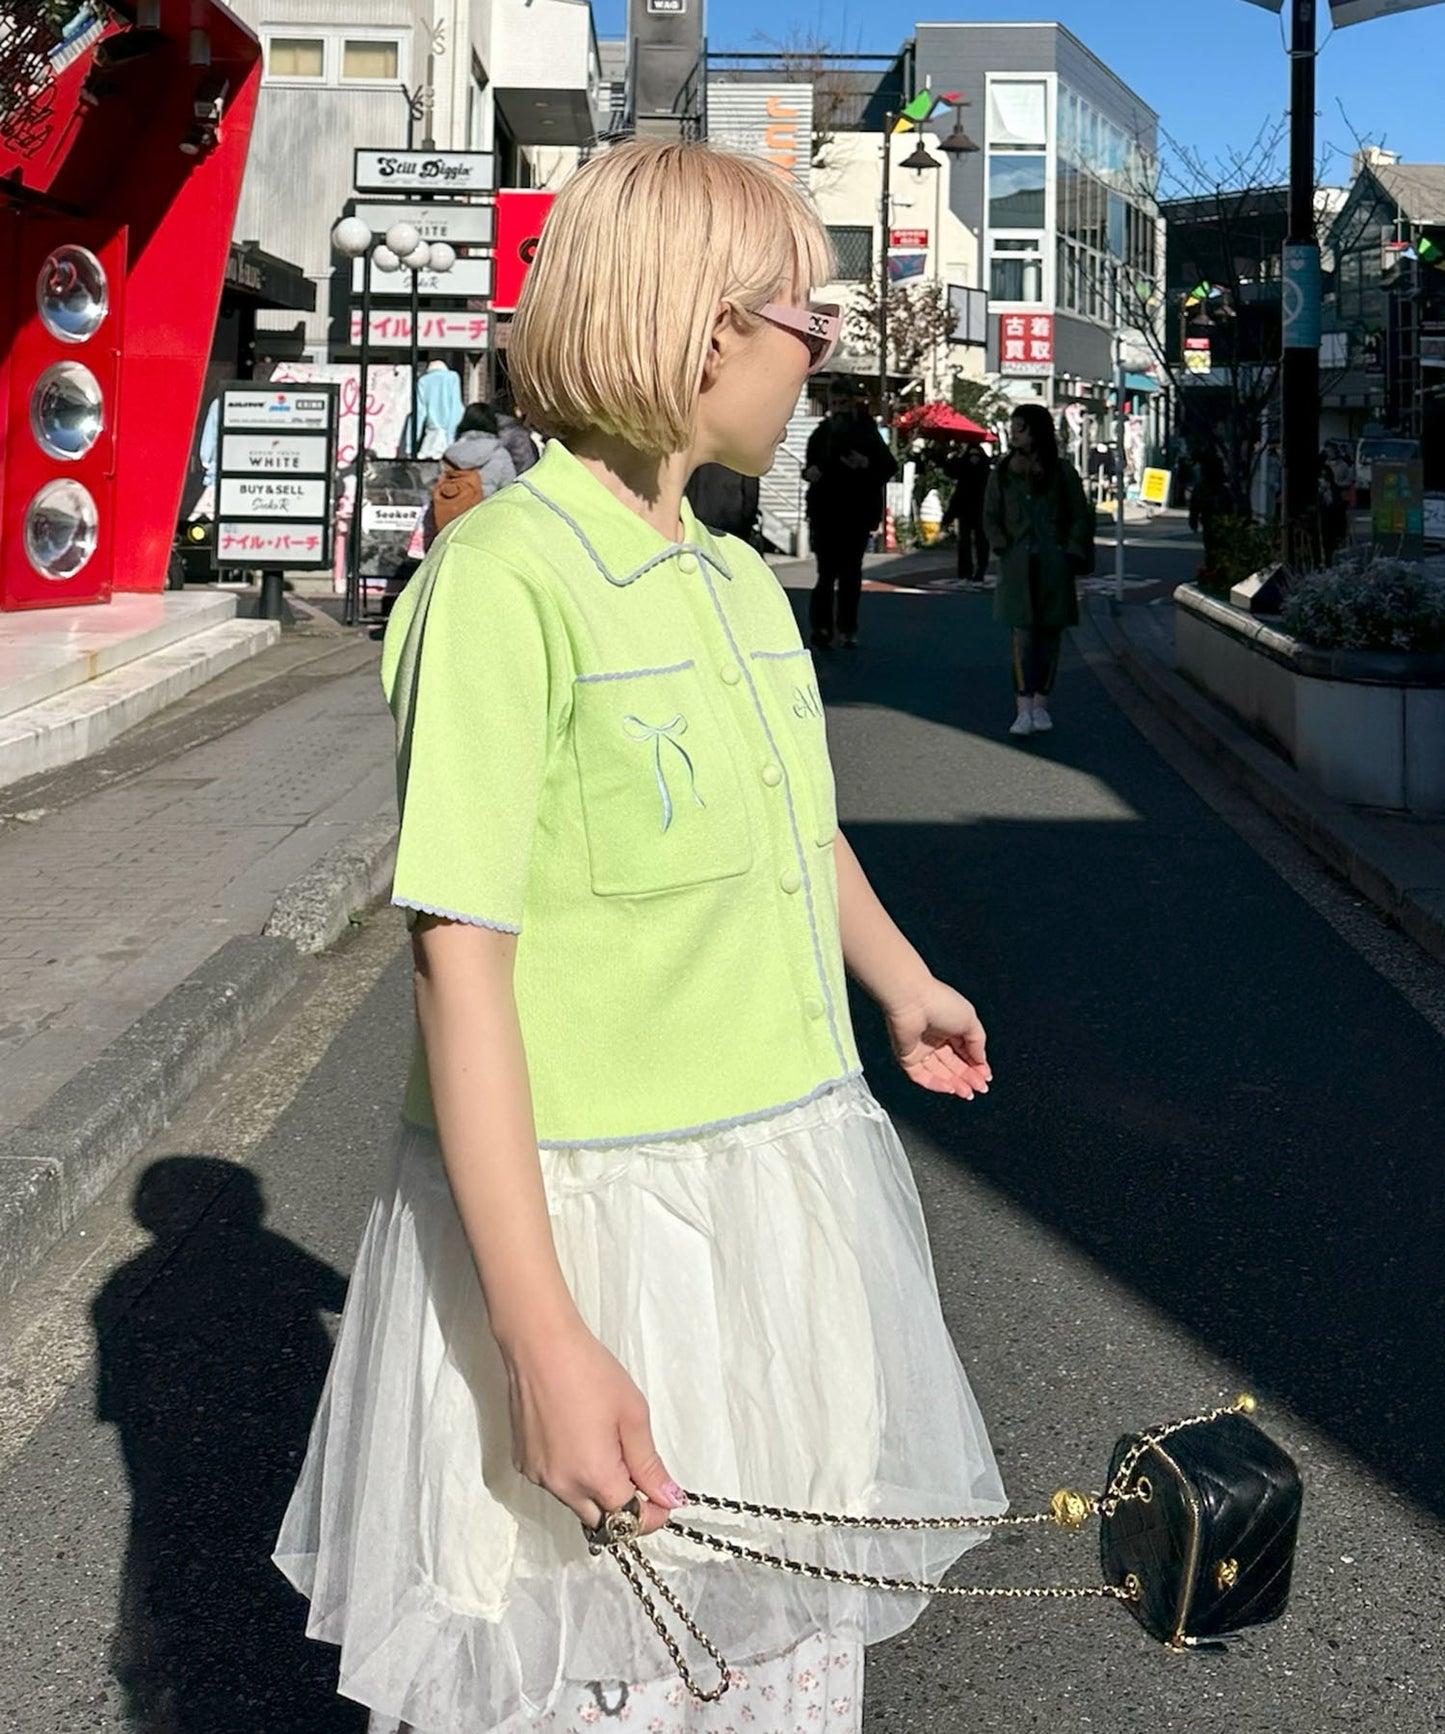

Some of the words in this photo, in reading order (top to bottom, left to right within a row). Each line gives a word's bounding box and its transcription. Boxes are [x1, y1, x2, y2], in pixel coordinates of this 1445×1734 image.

[377, 157, 417, 176] Still
[414, 225, 448, 237] HITE
[249, 457, 299, 468] WHITE
